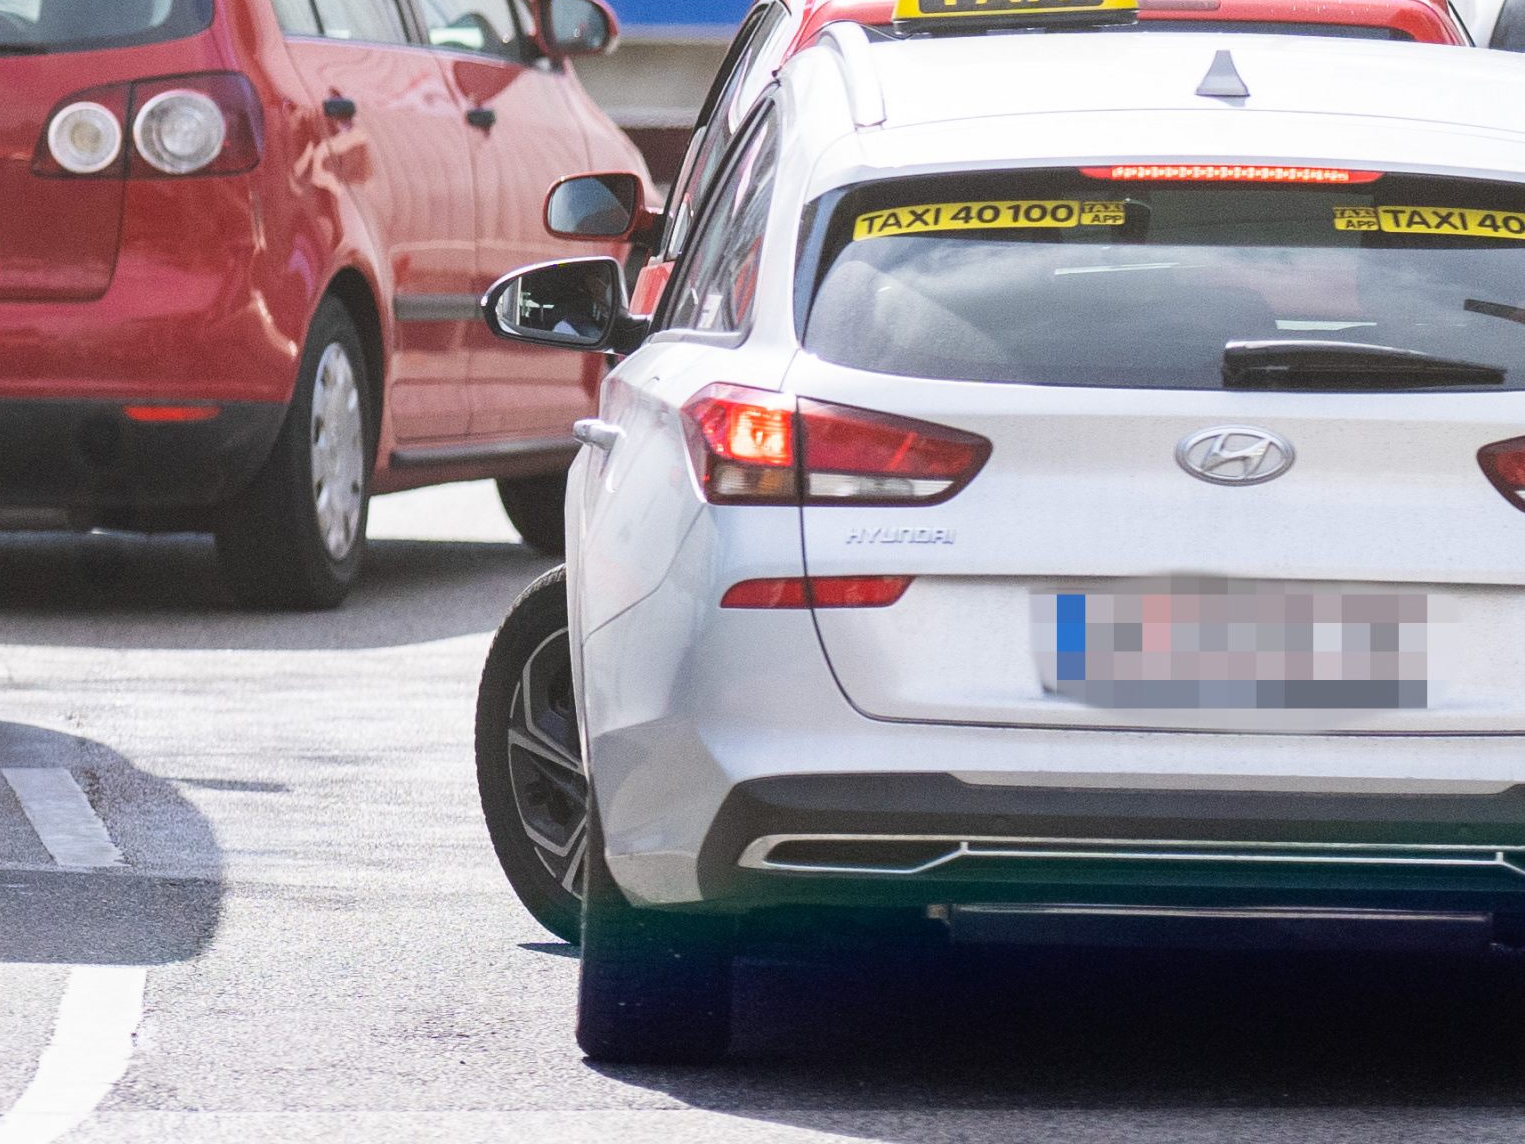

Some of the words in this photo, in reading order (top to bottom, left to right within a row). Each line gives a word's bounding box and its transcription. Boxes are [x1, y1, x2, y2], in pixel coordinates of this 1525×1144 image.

[860, 206, 940, 235] TAXI
[949, 203, 1074, 227] 40100
[1090, 213, 1122, 224] APP
[1346, 219, 1375, 229] APP
[1382, 209, 1469, 231] TAXI
[845, 527, 956, 545] HYUNDAI
